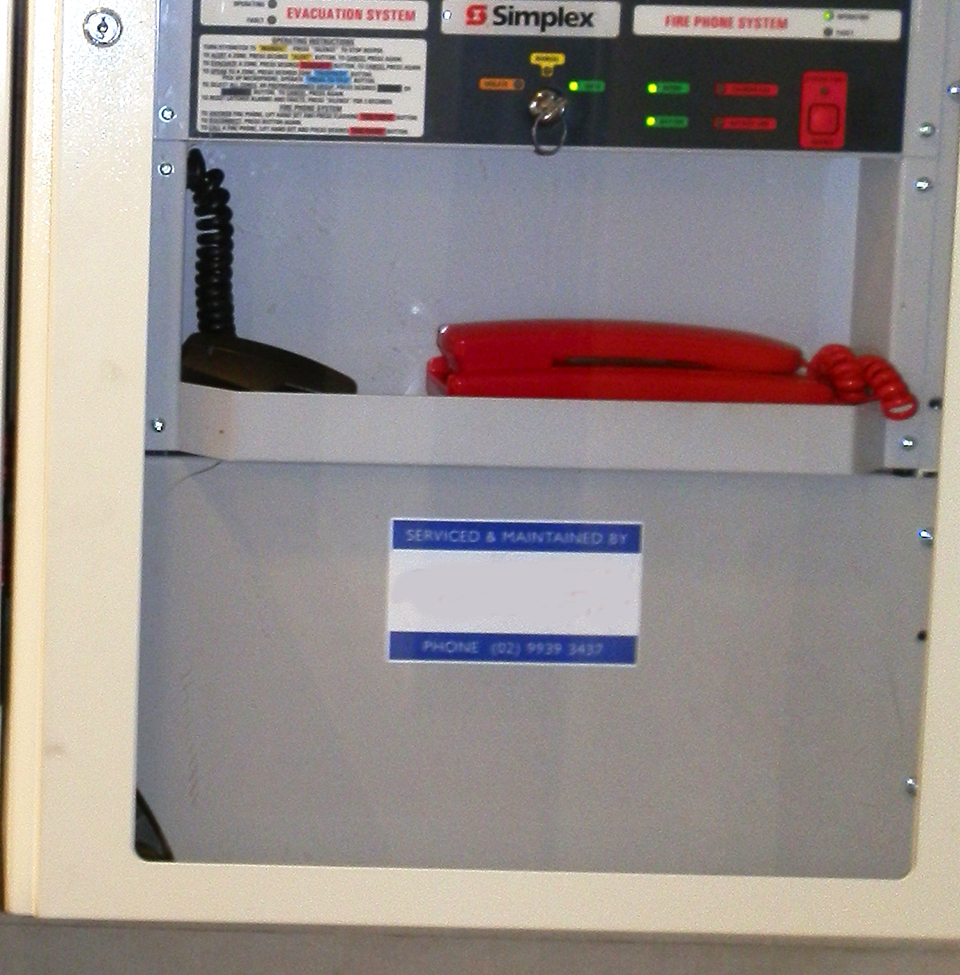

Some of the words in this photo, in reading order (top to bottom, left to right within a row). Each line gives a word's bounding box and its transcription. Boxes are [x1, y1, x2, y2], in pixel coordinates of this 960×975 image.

[285, 7, 363, 21] EVACUATION
[365, 8, 416, 22] SYSTEM
[492, 5, 595, 33] Simplex
[664, 14, 690, 28] FIRE
[693, 15, 733, 29] PHONE
[737, 16, 789, 30] SYSTEM
[405, 529, 481, 543] SERVICED
[485, 530, 497, 543] &
[501, 531, 604, 545] MAINTAINED
[607, 533, 628, 545] BY
[421, 640, 480, 653] PHONE
[490, 641, 522, 657] (02)
[526, 642, 563, 655] 9939
